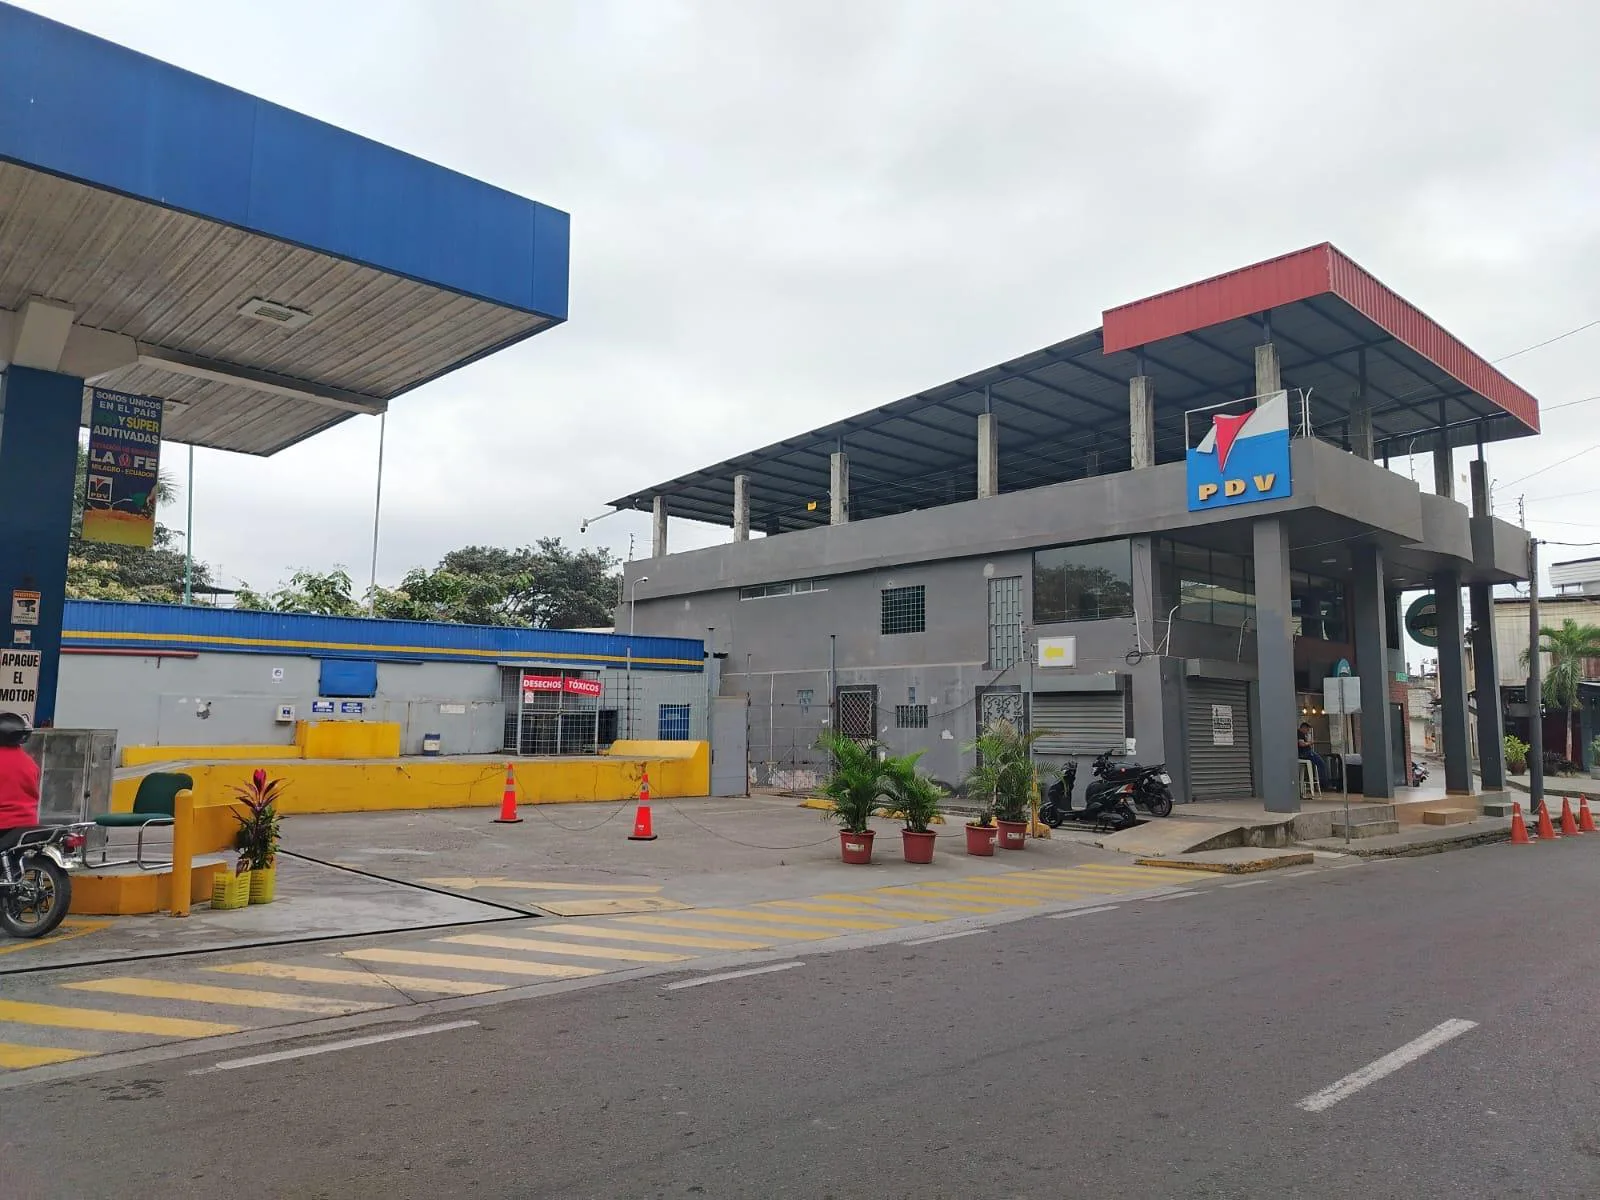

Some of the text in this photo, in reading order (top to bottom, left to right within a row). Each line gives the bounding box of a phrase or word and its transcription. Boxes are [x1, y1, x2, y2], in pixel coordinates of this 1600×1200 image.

[96, 391, 127, 404] SOMOS
[99, 401, 157, 418] EN EL PAÍS
[118, 414, 159, 433] Y SÚPER
[93, 425, 159, 445] ADITIVADAS
[91, 449, 115, 464] LA
[133, 455, 157, 471] FE
[91, 463, 120, 473] MILAGRO
[125, 469, 155, 478] ECUADOR
[1198, 473, 1276, 502] PDV
[1, 653, 39, 667] APAGUE
[13, 671, 24, 685] EL
[523, 679, 599, 693] DESECHOS TÓXICOS
[0, 689, 35, 702] MOTOR
